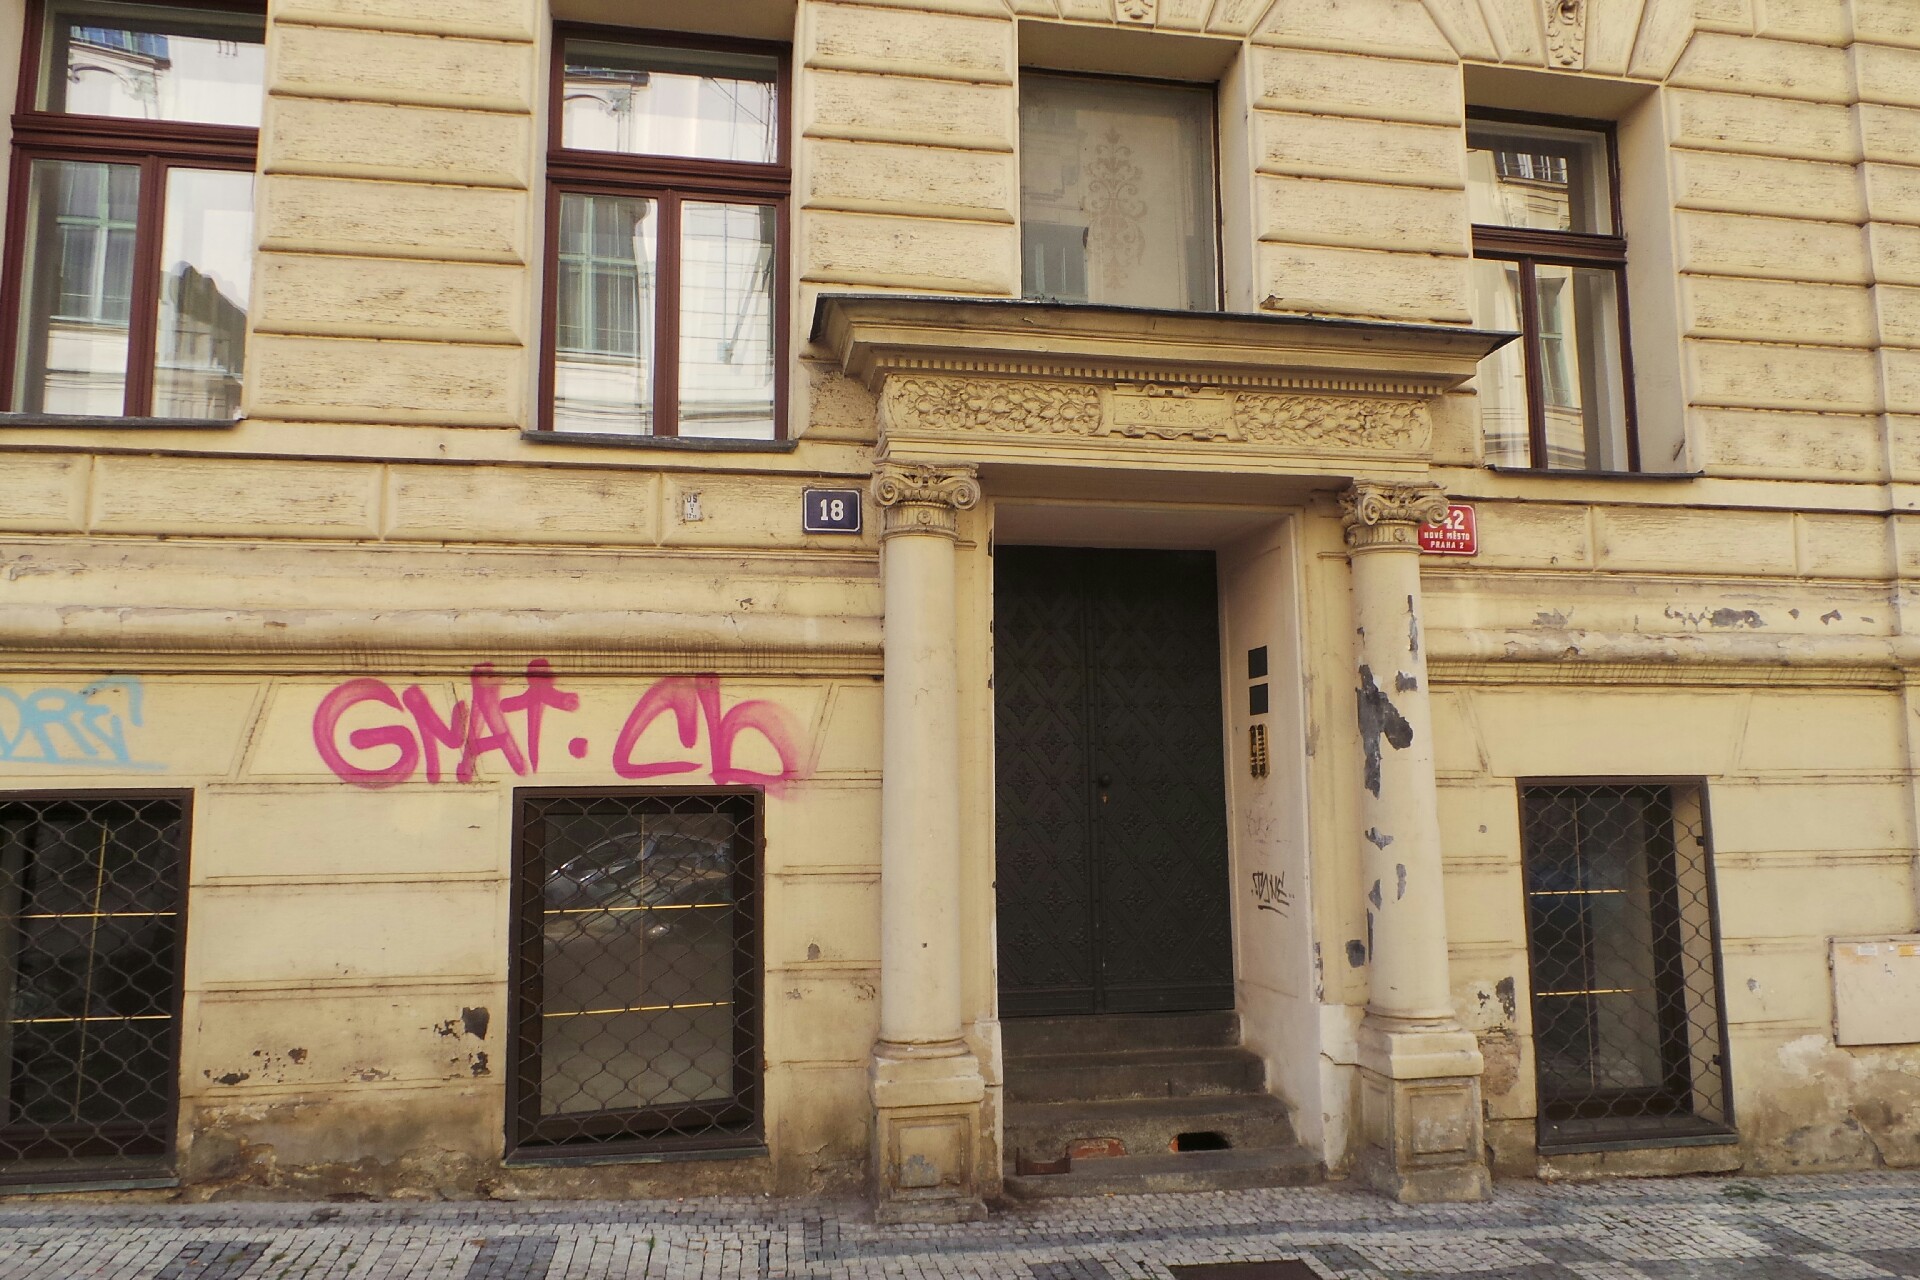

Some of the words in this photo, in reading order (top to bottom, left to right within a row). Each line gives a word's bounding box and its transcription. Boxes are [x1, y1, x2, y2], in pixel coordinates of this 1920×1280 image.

[820, 499, 844, 521] 18
[1424, 530, 1444, 540] NOVÉ
[1446, 531, 1470, 541] MĚSTO
[1430, 540, 1456, 549] PRAHA
